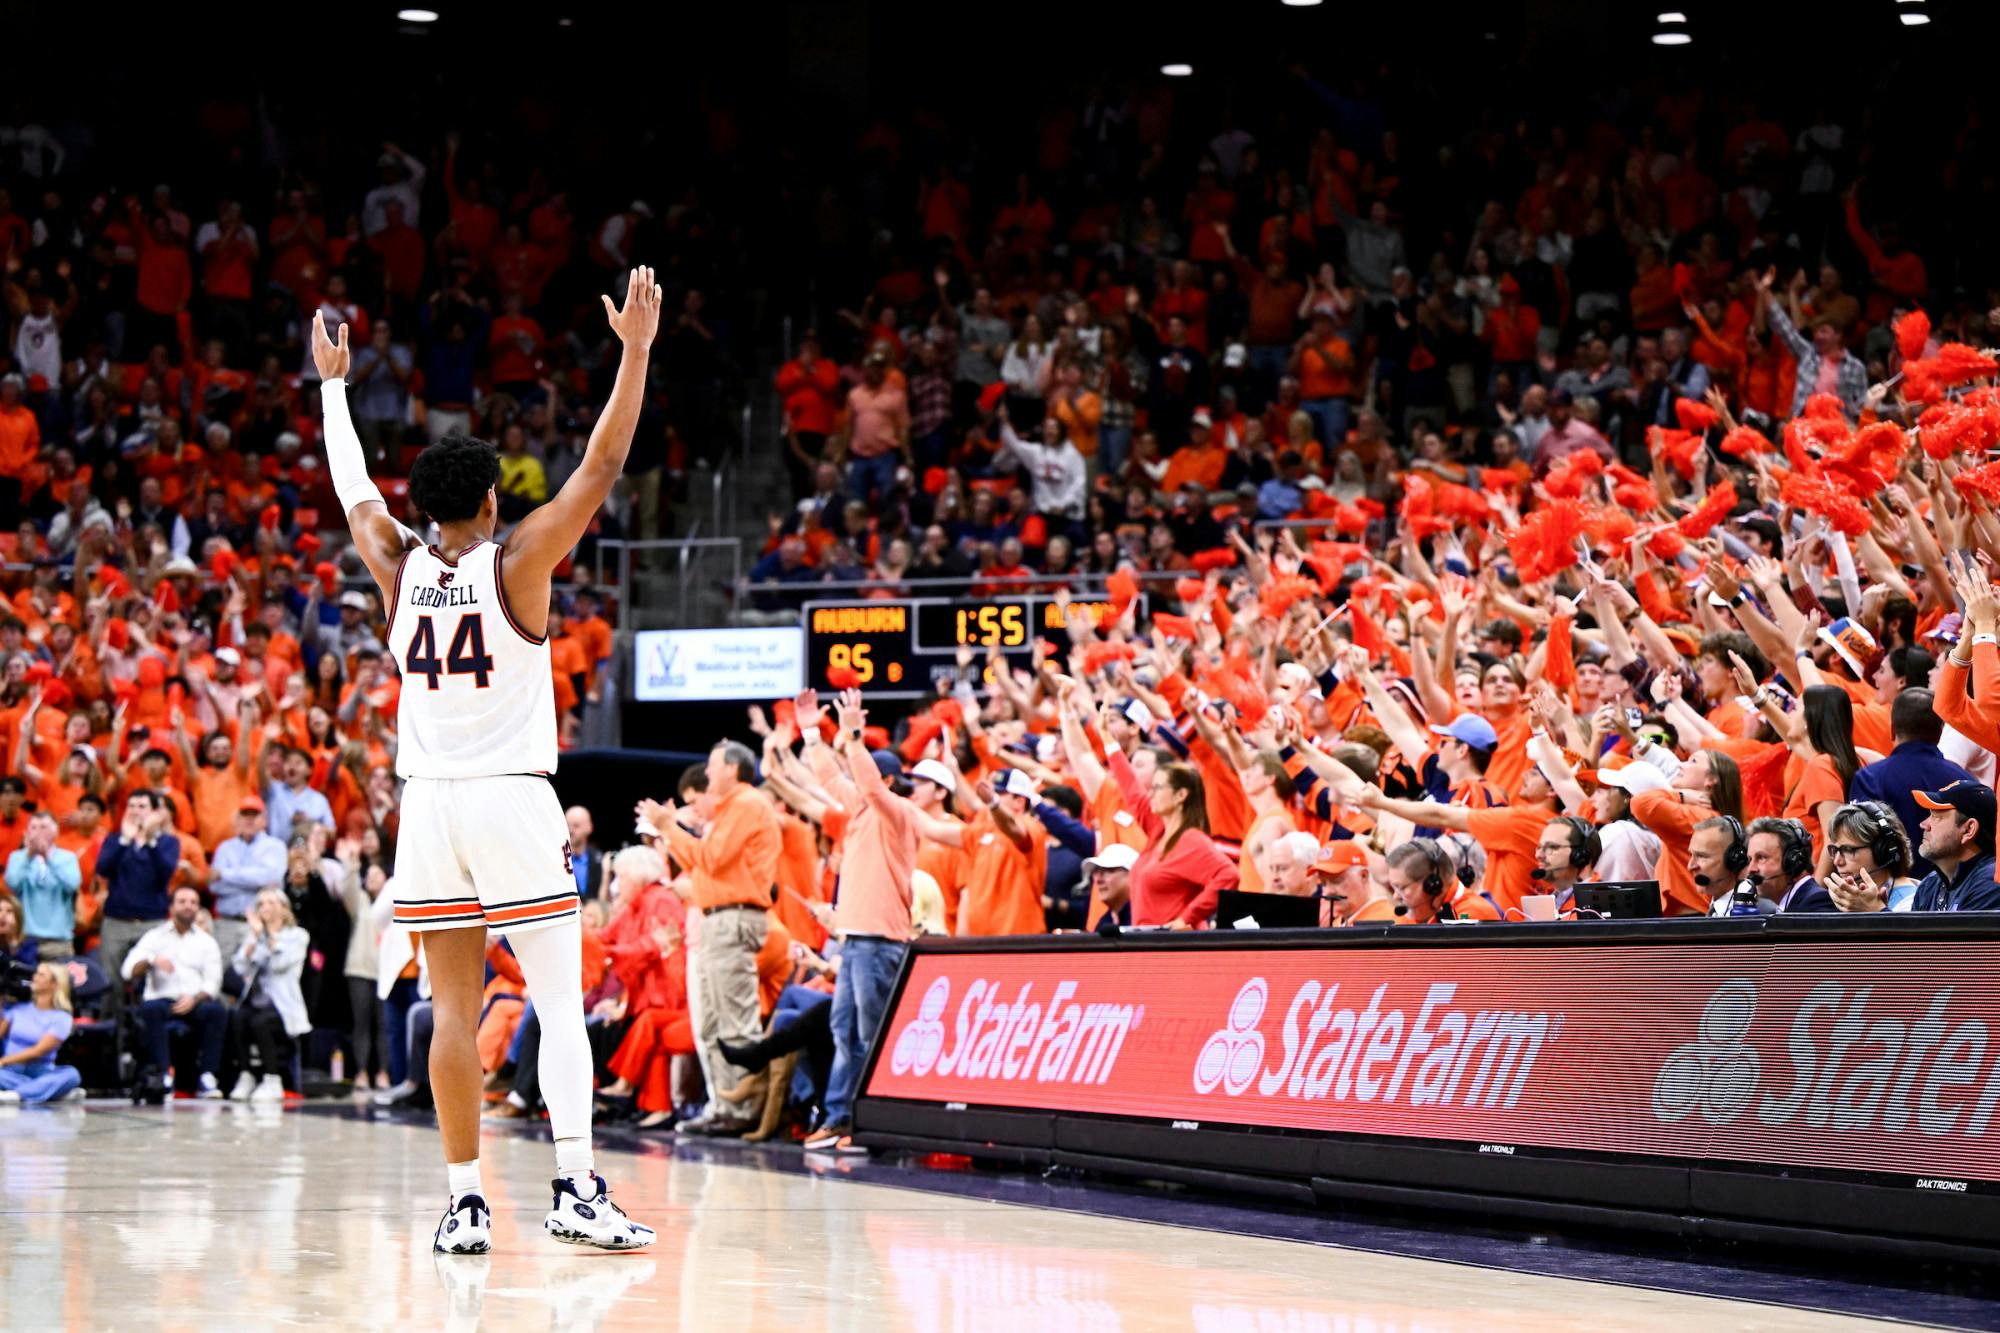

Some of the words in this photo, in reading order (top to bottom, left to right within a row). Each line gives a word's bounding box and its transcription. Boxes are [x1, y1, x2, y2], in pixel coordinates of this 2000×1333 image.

[956, 606, 1024, 646] 1:55
[406, 613, 494, 690] 44
[1916, 1179, 1968, 1192] DAKTRONICS
